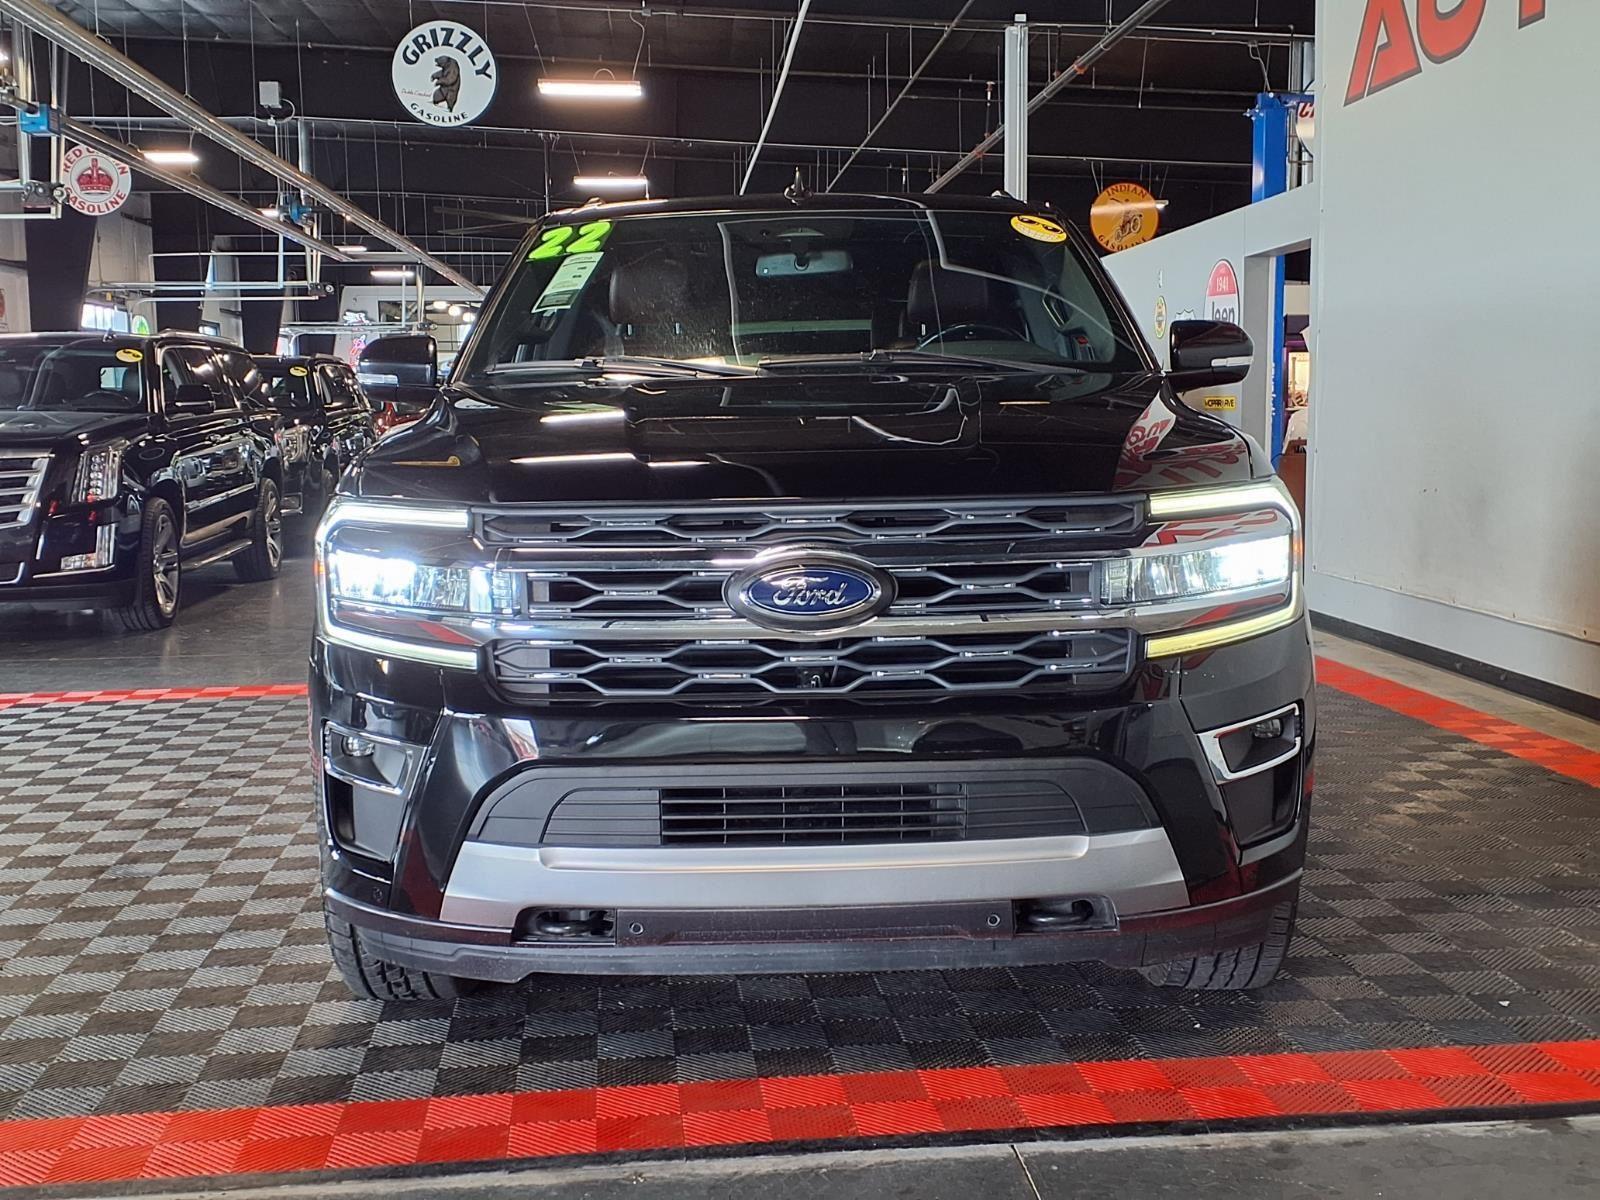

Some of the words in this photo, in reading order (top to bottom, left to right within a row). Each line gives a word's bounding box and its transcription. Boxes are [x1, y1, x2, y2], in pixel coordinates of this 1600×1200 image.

[402, 27, 493, 80] GRIZZLY
[410, 102, 469, 123] GASOLINE
[64, 187, 126, 214] GASOLINE
[1106, 184, 1147, 199] INDIAN
[527, 220, 612, 261] 22
[1216, 275, 1229, 292] 1941
[772, 576, 848, 605] Ford
